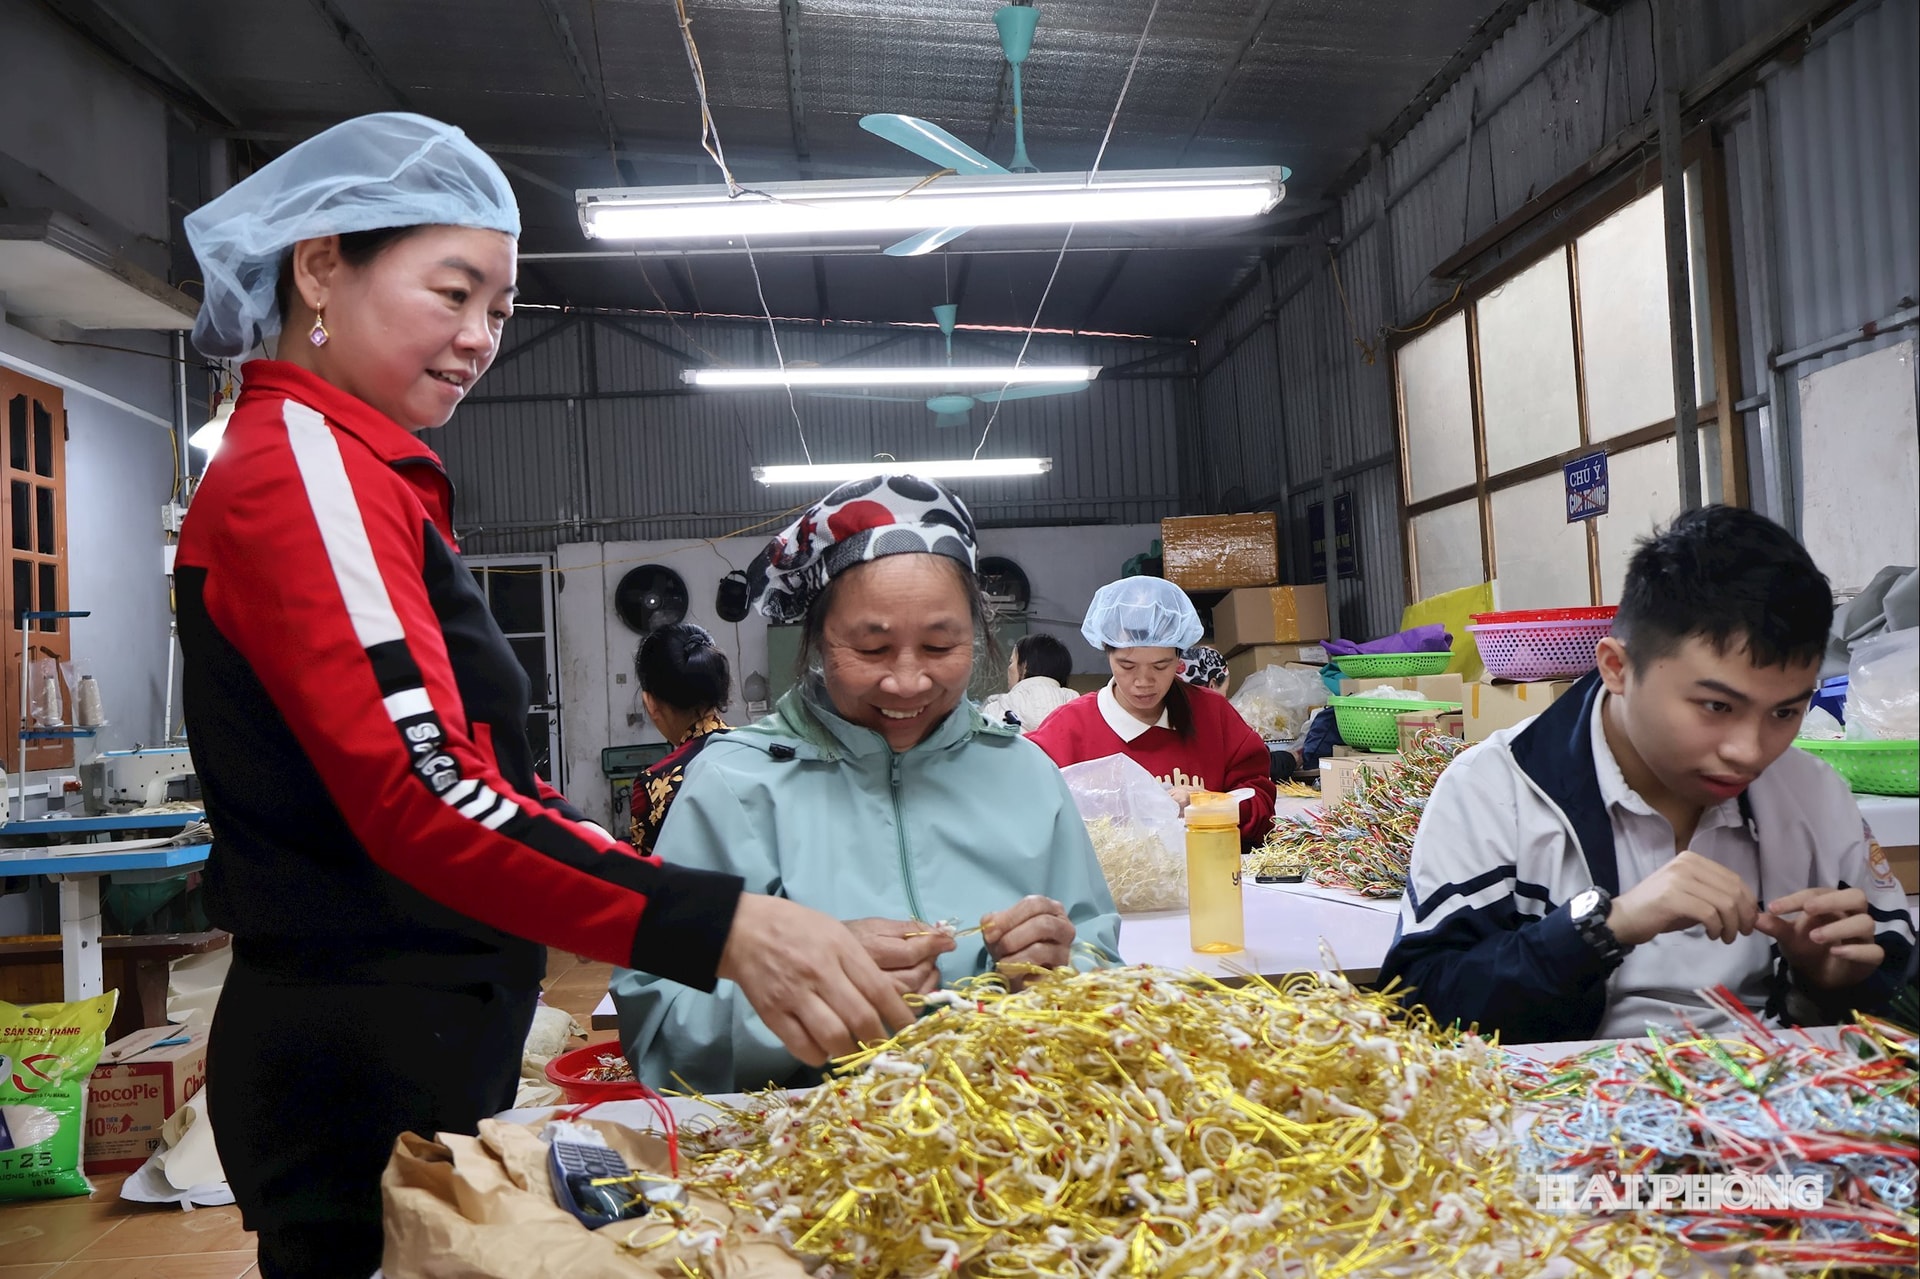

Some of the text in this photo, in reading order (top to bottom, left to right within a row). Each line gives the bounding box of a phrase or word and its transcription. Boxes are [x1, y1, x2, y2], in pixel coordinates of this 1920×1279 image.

[1569, 460, 1602, 487] CHÚ Ý
[89, 1083, 159, 1103] hocoPie
[20, 1152, 53, 1169] 25
